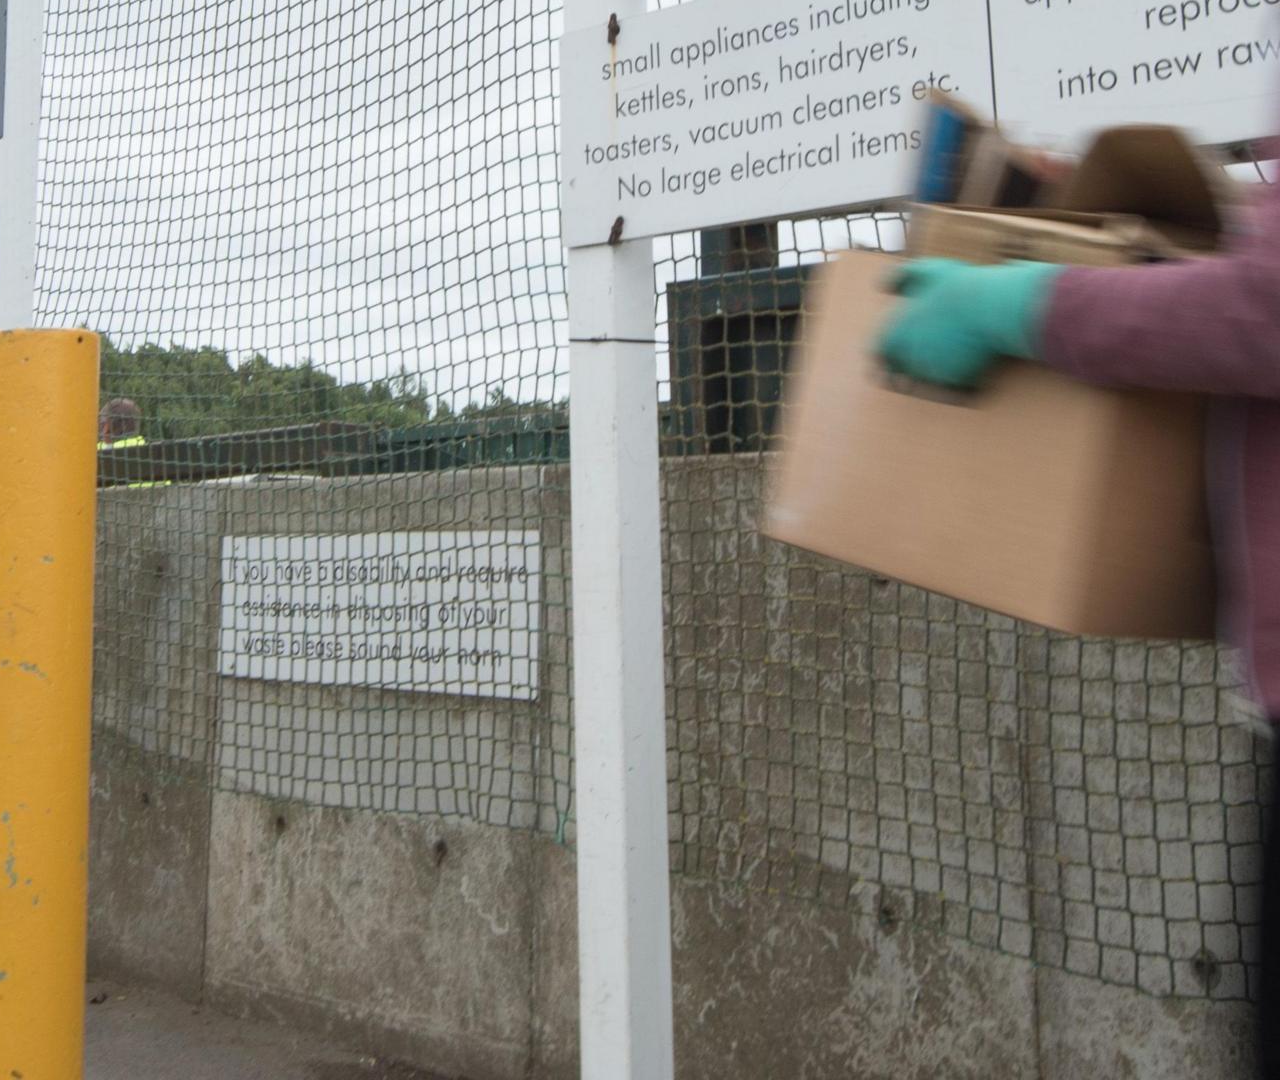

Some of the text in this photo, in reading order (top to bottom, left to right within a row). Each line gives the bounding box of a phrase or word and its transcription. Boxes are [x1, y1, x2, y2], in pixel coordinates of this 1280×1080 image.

[601, 44, 663, 81] small
[670, 17, 800, 71] appliances
[615, 34, 918, 118] kettles, irons, hairdryers,
[1056, 64, 1118, 99] into
[1132, 51, 1203, 85] new
[584, 70, 960, 165] toasters, vacuum cleaners etc.
[617, 126, 922, 201] No large electrical items
[228, 556, 238, 580] If
[242, 560, 269, 582] you
[275, 558, 312, 581] have
[332, 555, 410, 588] disability
[415, 557, 451, 581] and
[457, 561, 528, 589] require
[241, 593, 507, 629] assistance in disposing of your
[241, 632, 502, 670] waste please sound your horn
